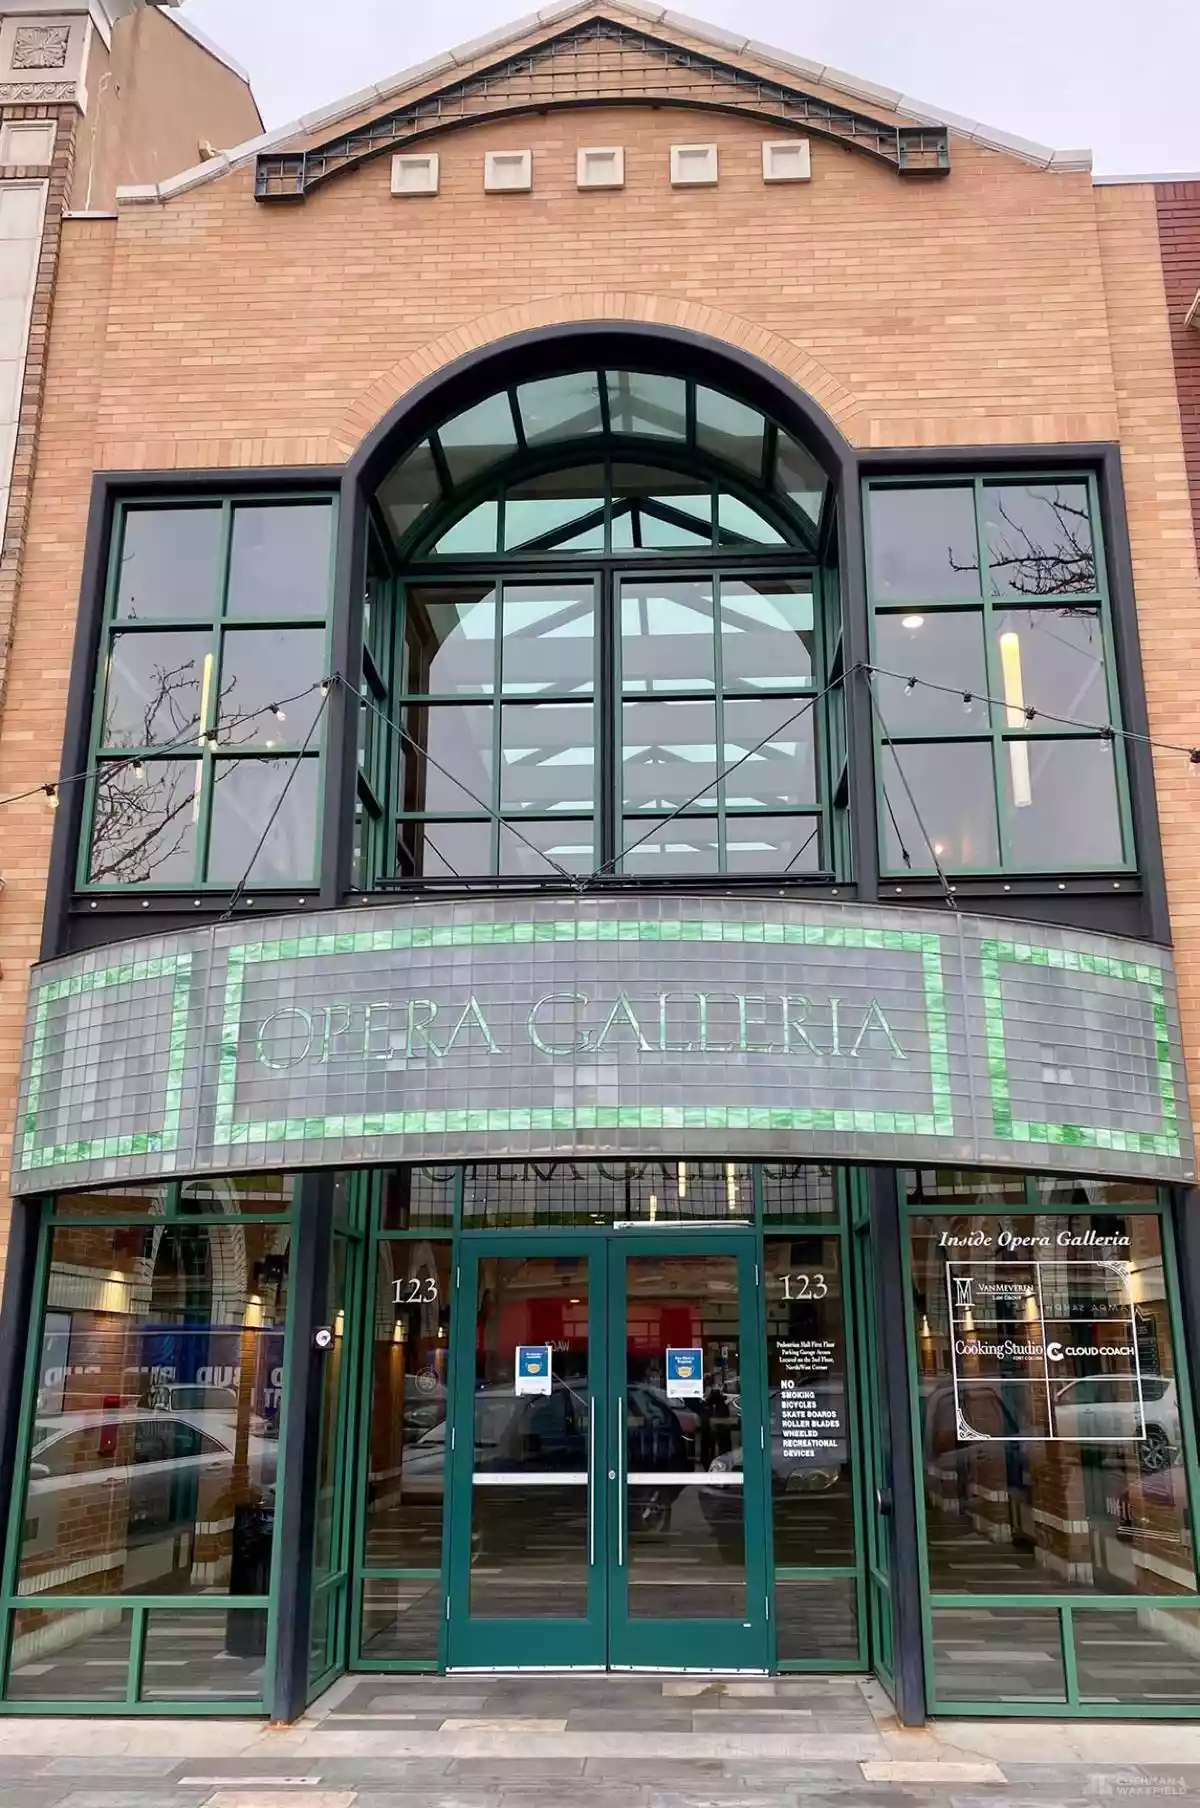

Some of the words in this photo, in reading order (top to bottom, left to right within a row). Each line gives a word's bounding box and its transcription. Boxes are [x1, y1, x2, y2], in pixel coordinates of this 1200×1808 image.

[257, 995, 502, 1070] OPERA
[527, 991, 909, 1060] GALLERIA
[939, 1230, 992, 1247] Inside
[998, 1231, 1050, 1251] Opera
[1056, 1230, 1131, 1247] Galleria
[391, 1278, 438, 1303] 123
[779, 1273, 828, 1300] 123
[1065, 1346, 1098, 1356] CLOUD
[1099, 1346, 1135, 1356] COACH
[780, 1380, 795, 1389] NO
[781, 1391, 815, 1399] SMOKING
[781, 1401, 817, 1409] BICYCLES
[782, 1420, 810, 1428] ROLLER
[811, 1420, 840, 1428] BLADES
[783, 1439, 838, 1447] RECREATIONAL
